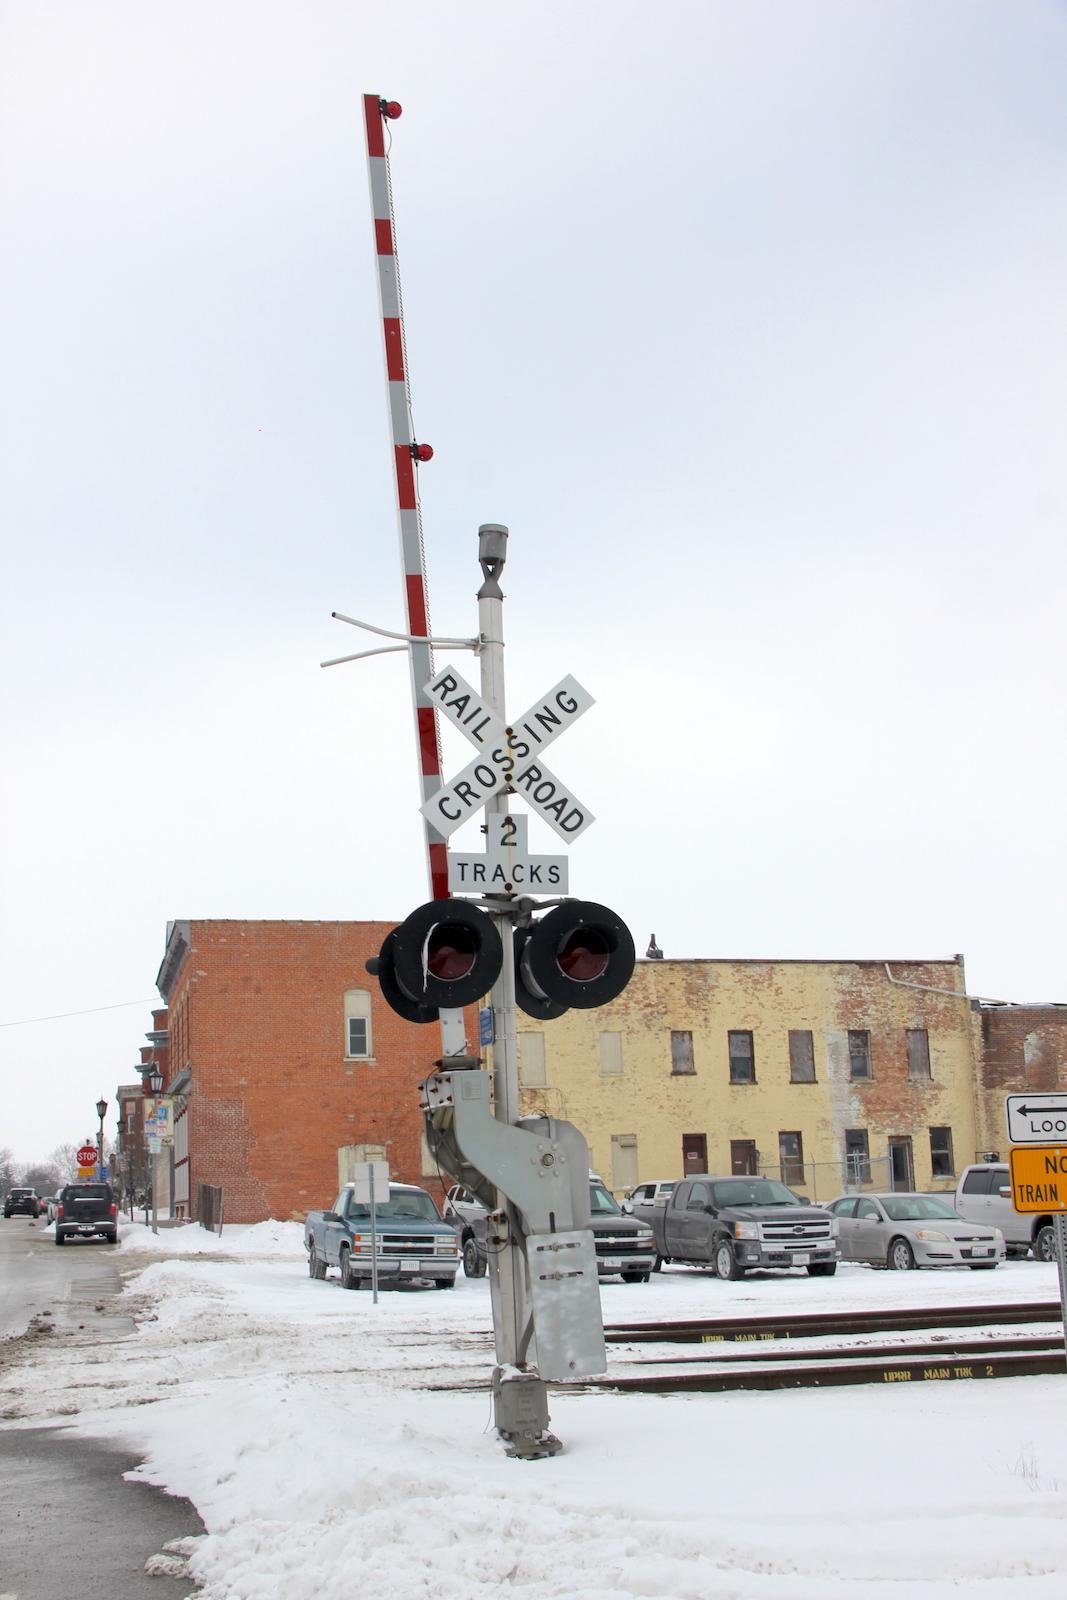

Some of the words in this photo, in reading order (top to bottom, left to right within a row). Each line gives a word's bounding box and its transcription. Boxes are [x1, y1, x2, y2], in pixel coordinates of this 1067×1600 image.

[432, 674, 491, 743] RAIL
[517, 764, 584, 833] ROAD
[438, 690, 578, 821] CROSSING
[500, 820, 517, 847] 2
[457, 862, 560, 884] TRACKS
[78, 1152, 97, 1160] STOP
[1018, 1184, 1058, 1202] TRAIN
[735, 1333, 757, 1341] MAIN
[760, 1333, 775, 1341] TRK
[884, 1370, 911, 1382] UPRR
[923, 1368, 950, 1380] MAIN
[954, 1366, 973, 1378] TRK
[985, 1365, 994, 1376] 2
